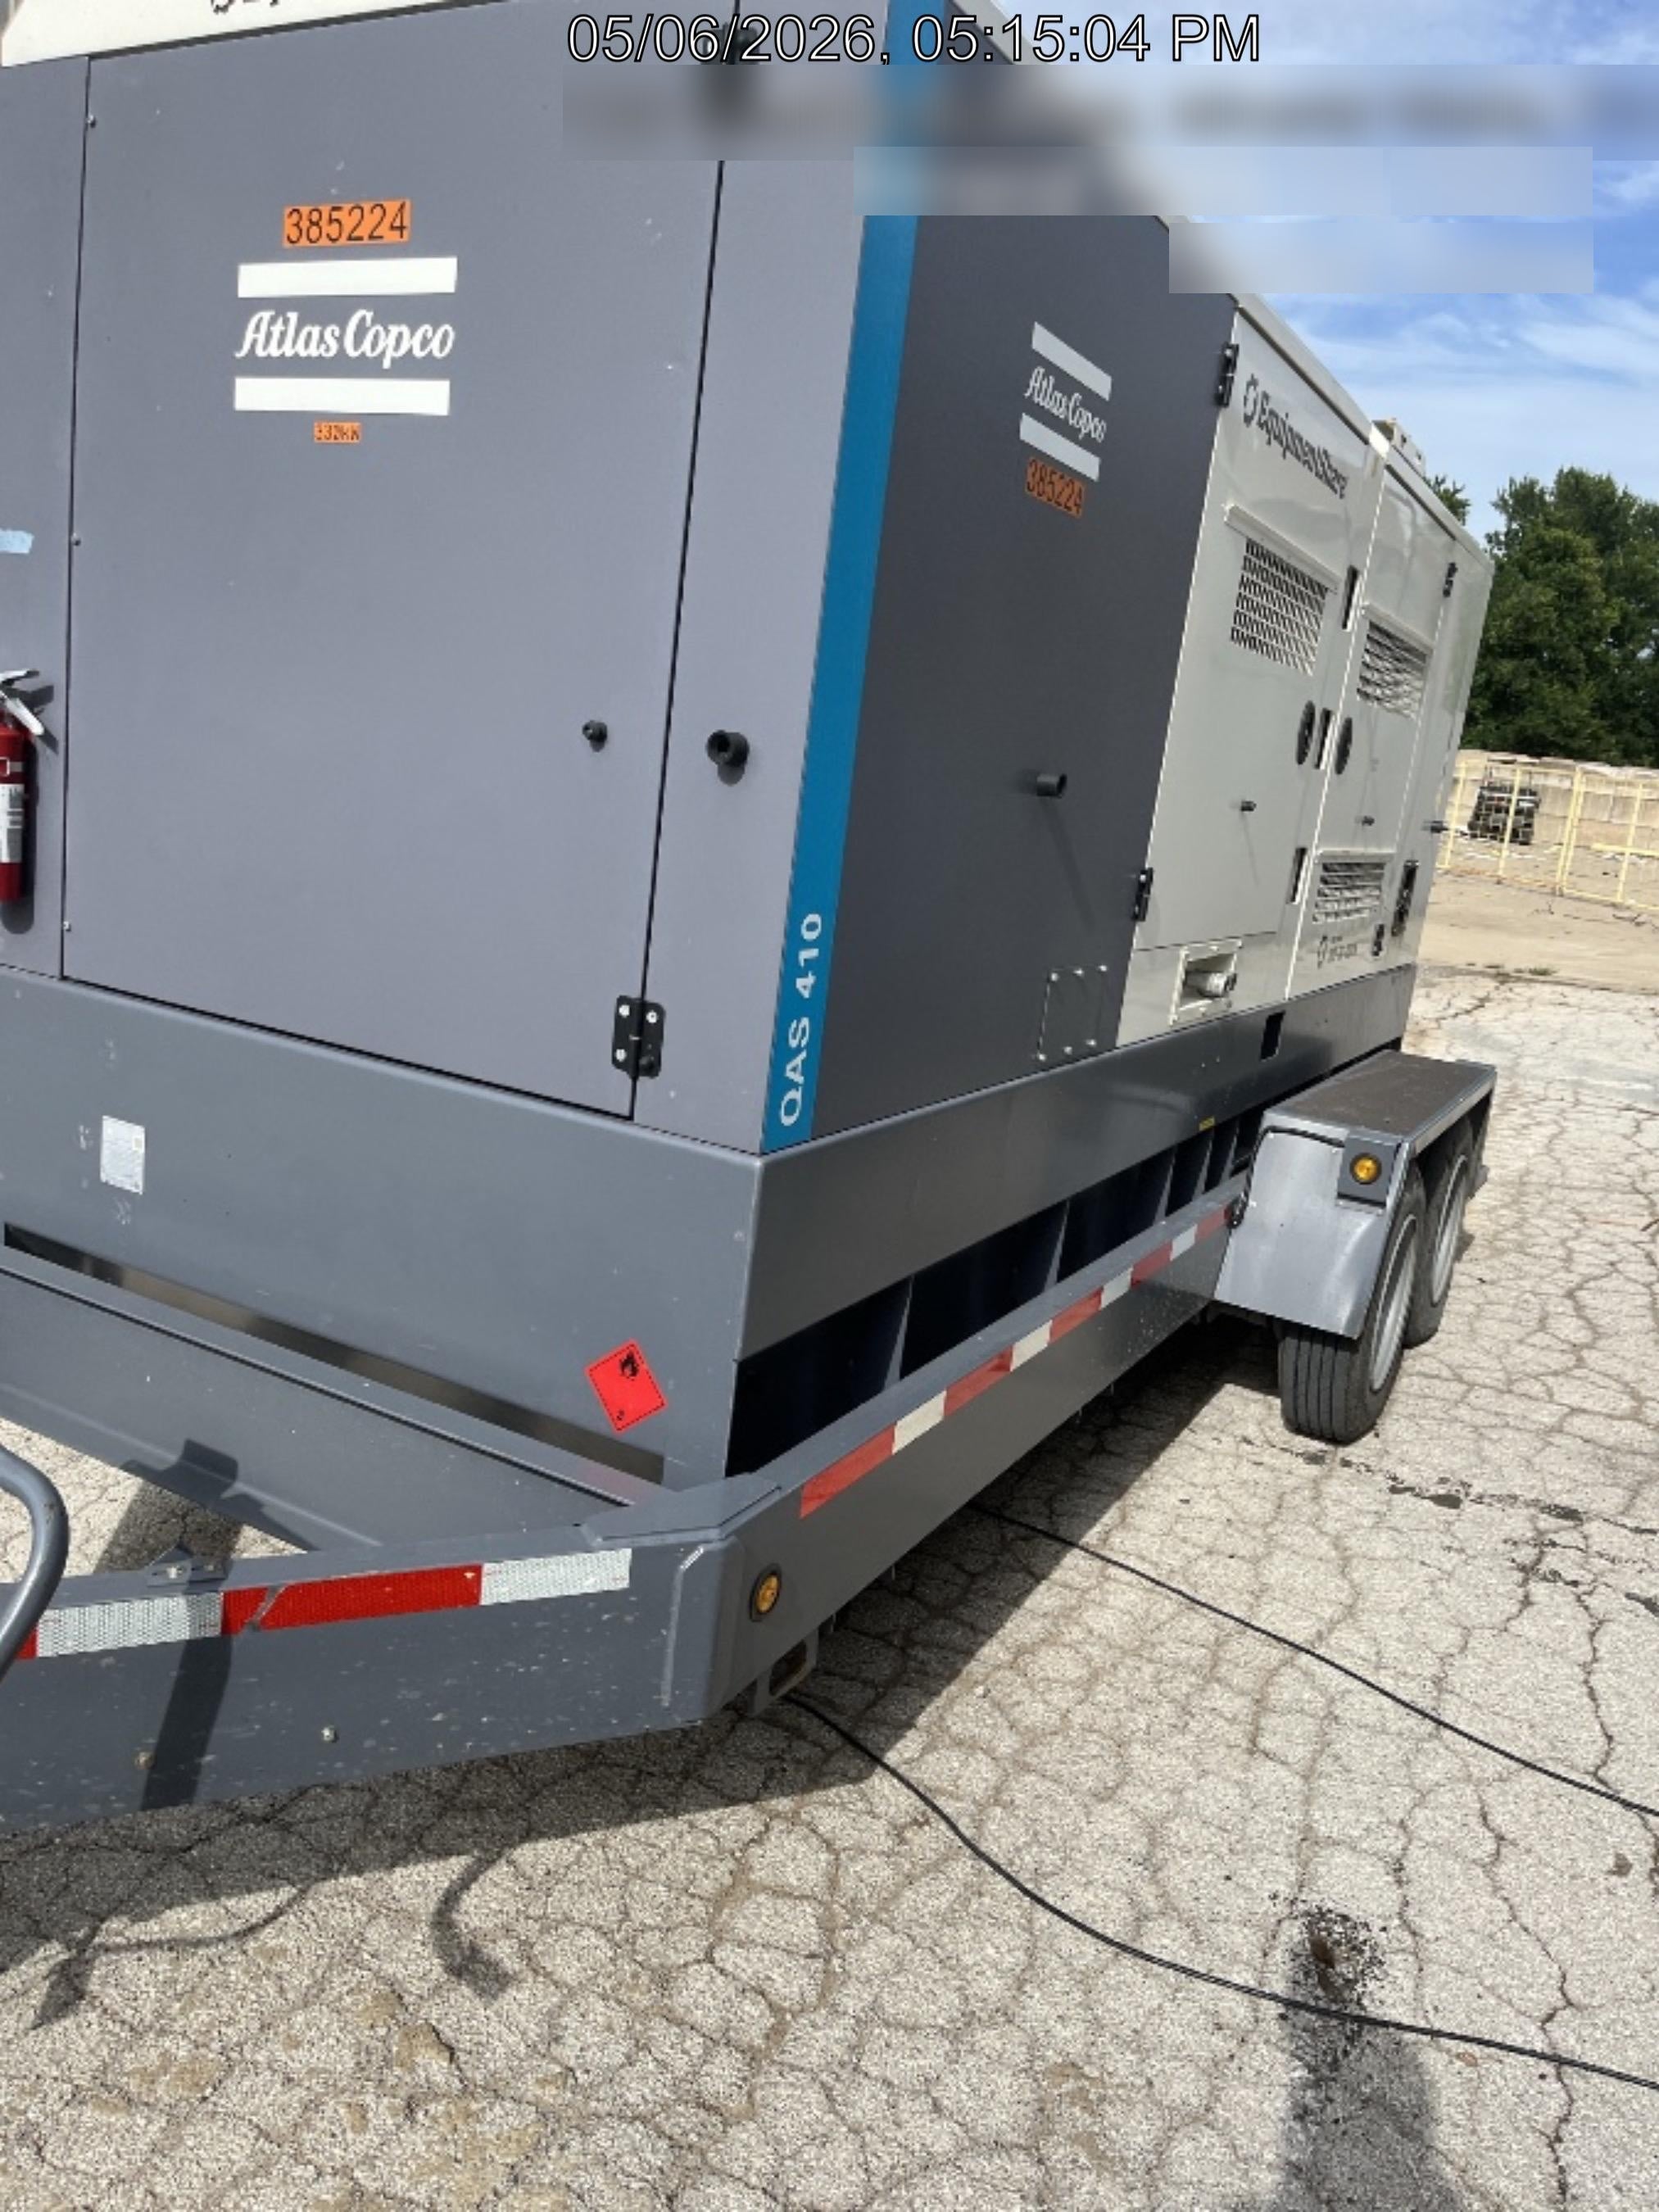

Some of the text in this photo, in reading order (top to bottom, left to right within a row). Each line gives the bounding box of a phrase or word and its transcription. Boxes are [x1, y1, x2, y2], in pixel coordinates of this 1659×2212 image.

[287, 201, 406, 244] 385224
[234, 309, 455, 369] Atlas Copco
[1024, 365, 1107, 443] Atlas Copco
[1027, 459, 1082, 515] 385224
[780, 913, 822, 1126] QAS 410
